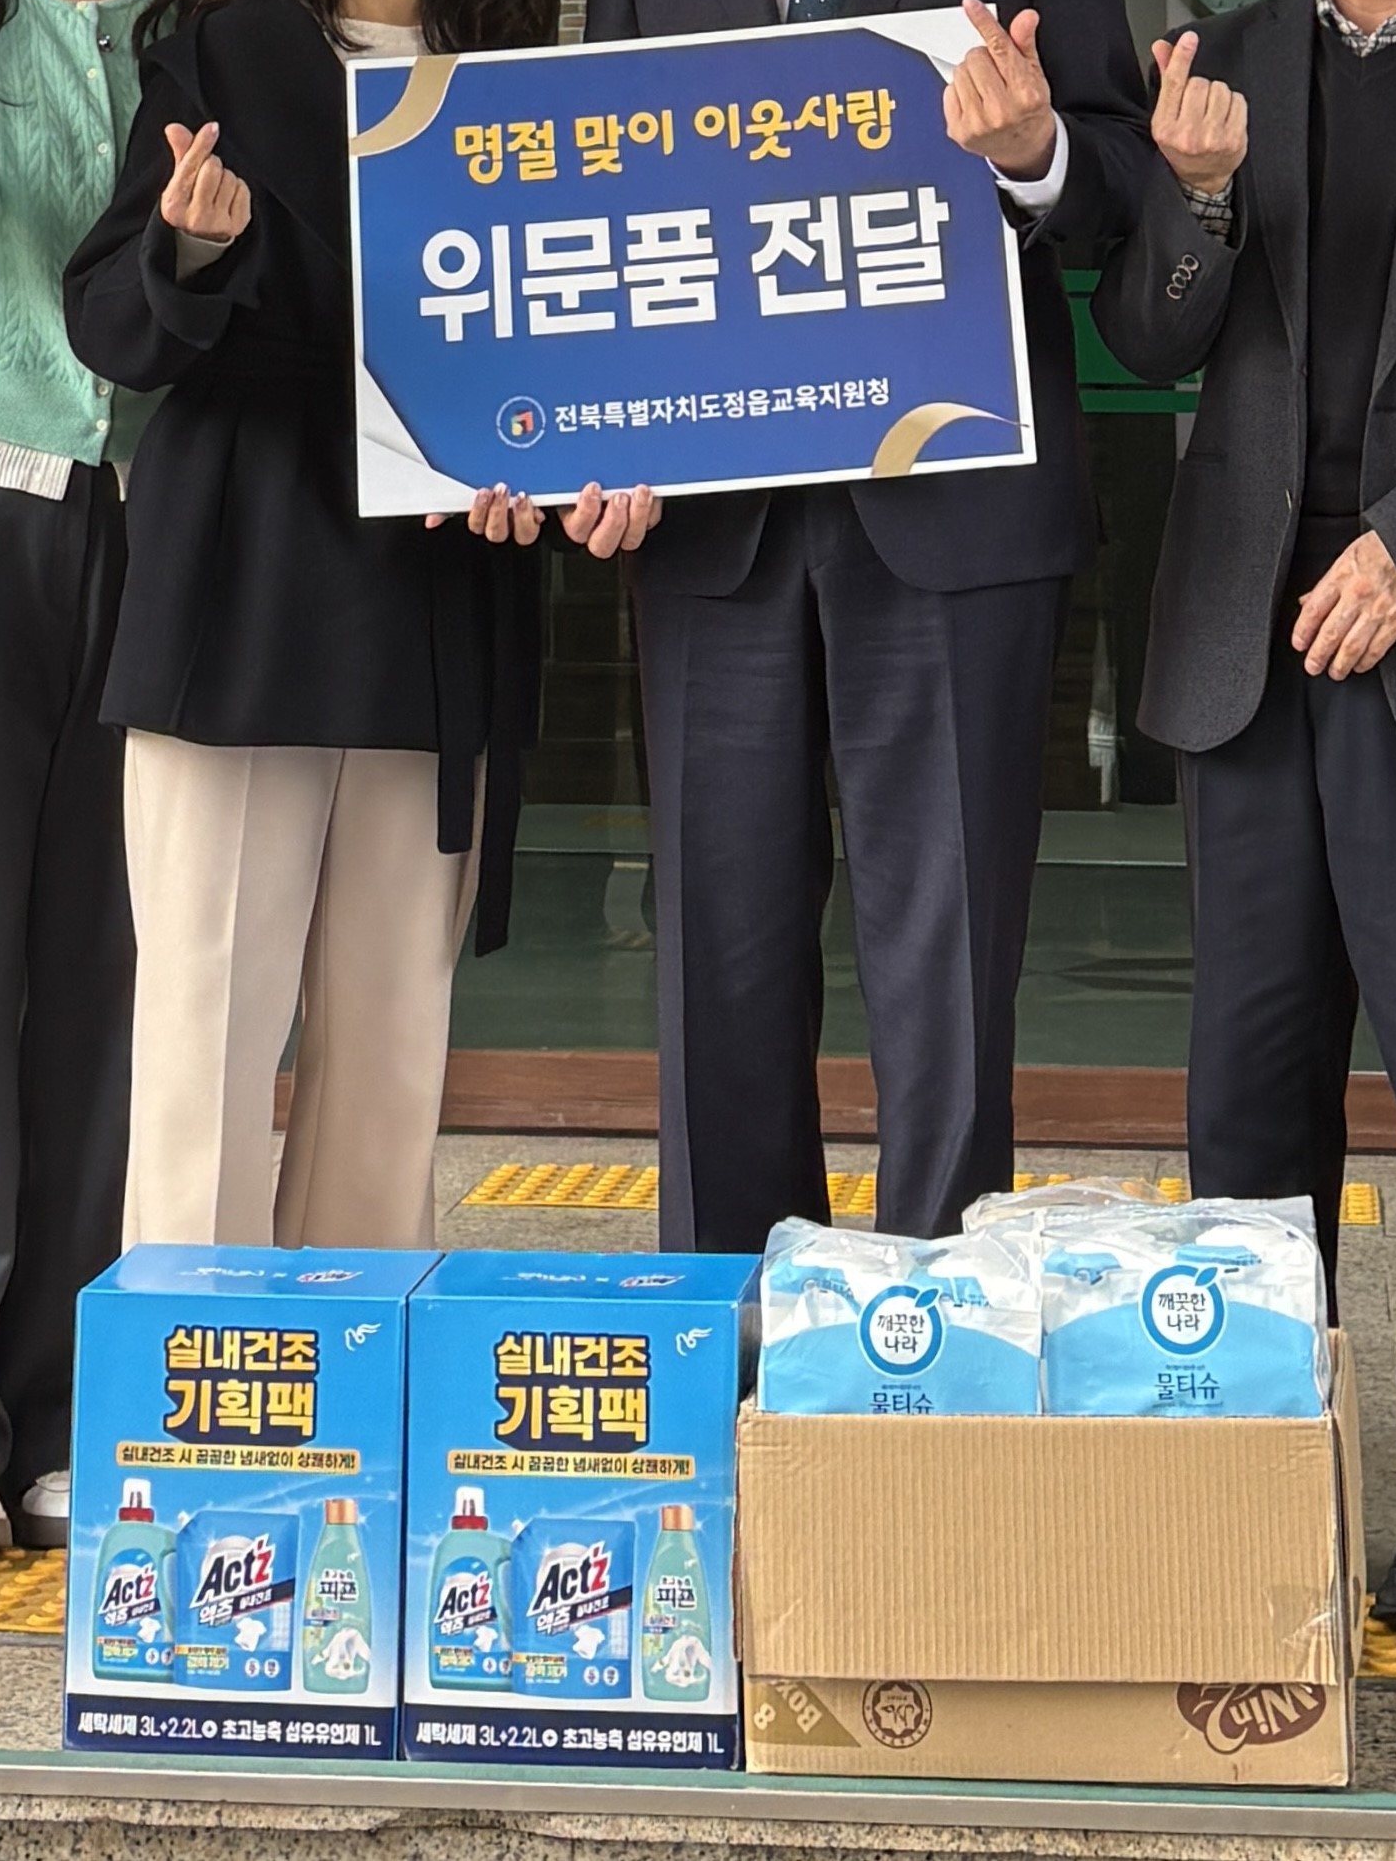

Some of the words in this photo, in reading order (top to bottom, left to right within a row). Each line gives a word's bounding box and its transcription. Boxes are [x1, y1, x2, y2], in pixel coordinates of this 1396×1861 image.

[455, 121, 558, 183] 명절
[575, 109, 674, 174] 맞이
[694, 89, 896, 163] 이웃사랑
[419, 208, 720, 342] 위문품
[749, 187, 950, 317] 전달
[554, 377, 890, 433] 전북특별자치도정읍교육지원청
[1158, 1292, 1206, 1312] 깨끗한
[877, 1314, 924, 1334] 깨끗한
[1167, 1314, 1200, 1332] 나라
[167, 1328, 317, 1371] 실내건조
[497, 1334, 648, 1377] 실내건조
[885, 1335, 919, 1353] 나라
[1155, 1372, 1221, 1401] 물티슈
[165, 1379, 315, 1436] 기획팩
[497, 1385, 647, 1442] 기획팩
[122, 1445, 174, 1462] 실내건조
[178, 1447, 192, 1464] 시
[454, 1452, 508, 1470] 실내건조
[512, 1455, 524, 1471] 시
[78, 1712, 137, 1736] 세탁세제
[221, 1719, 282, 1742] 초고농축
[286, 1721, 360, 1745] 섬유유연제
[364, 1724, 382, 1746] 1L
[754, 1702, 776, 1730] 8
[416, 1722, 477, 1746] 세탁세제
[562, 1728, 624, 1751] 초고농축
[627, 1730, 703, 1753] 섬유유연제
[707, 1732, 725, 1753] 1L
